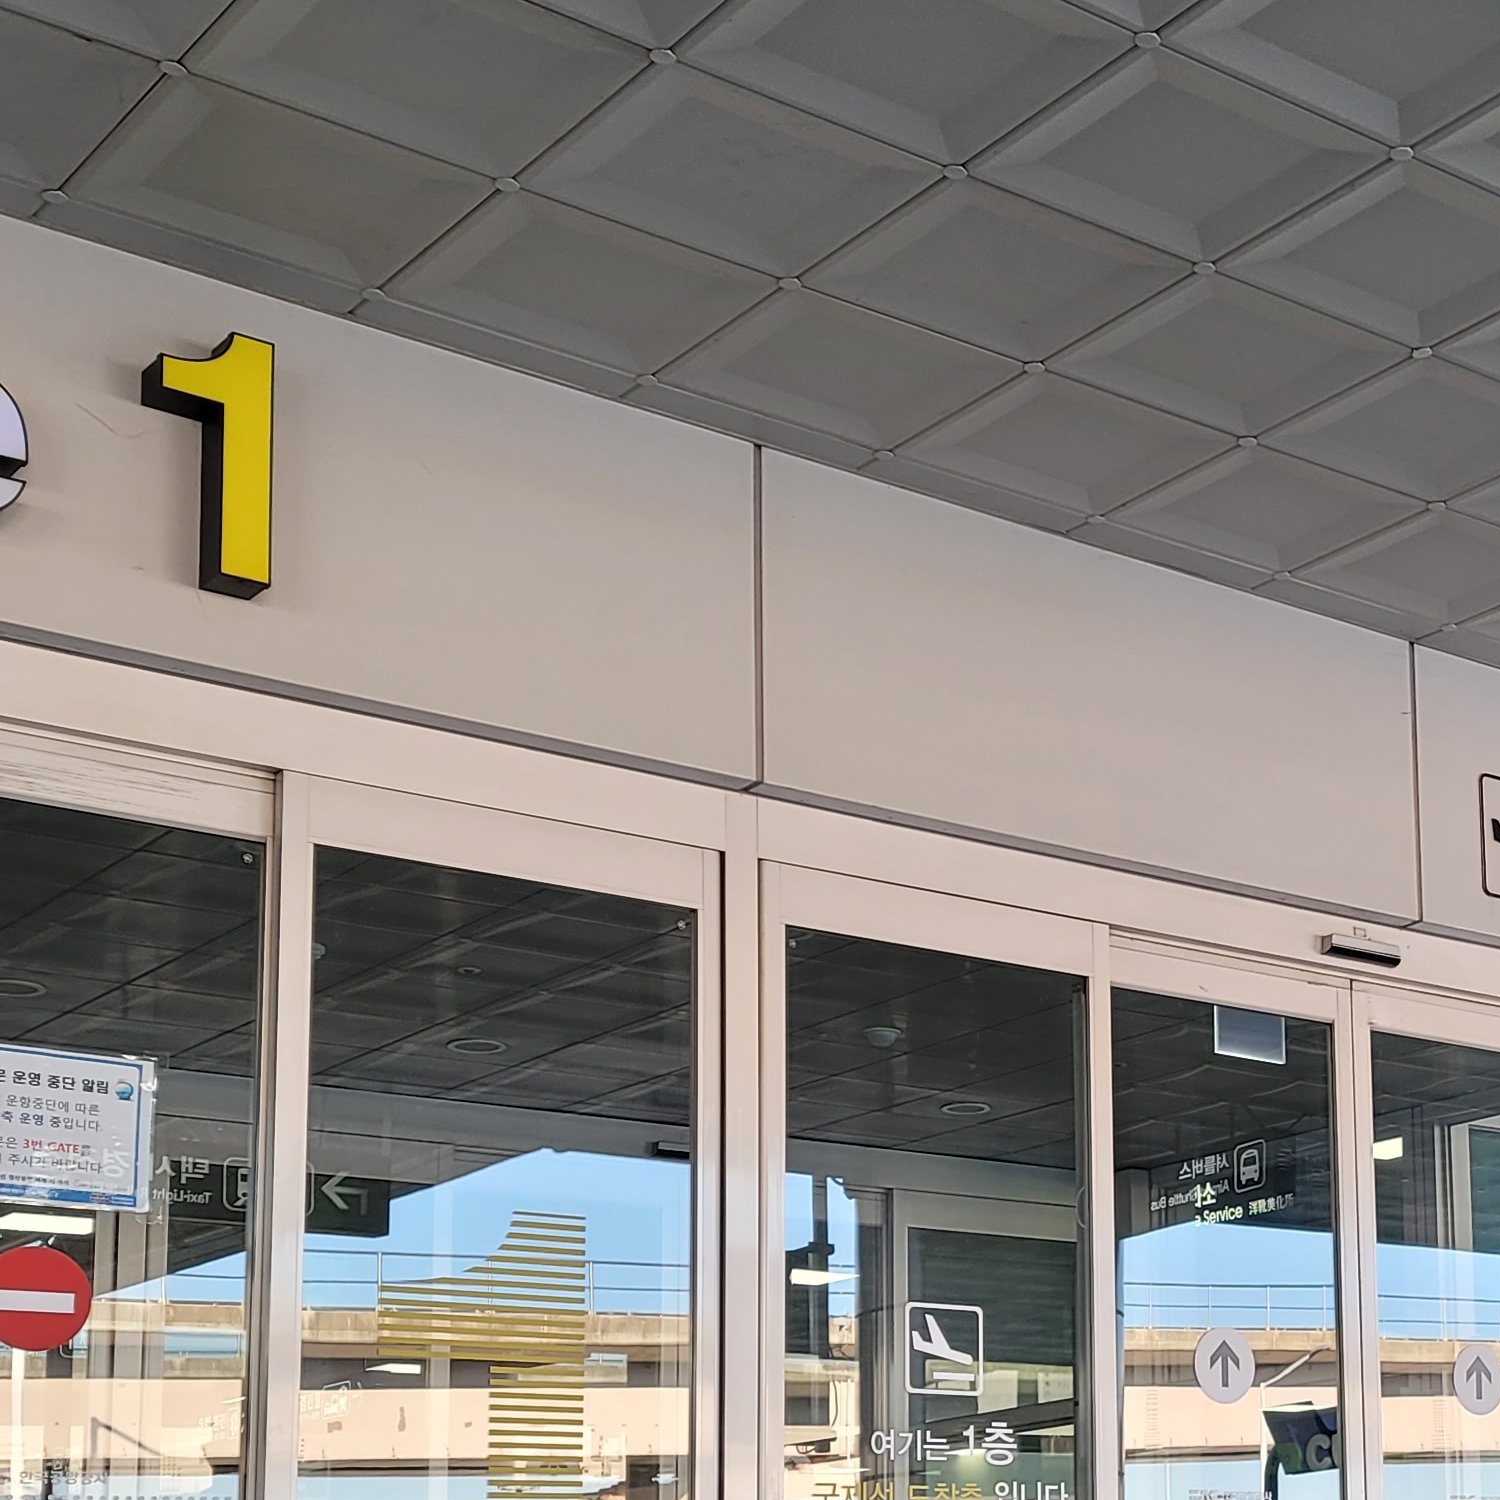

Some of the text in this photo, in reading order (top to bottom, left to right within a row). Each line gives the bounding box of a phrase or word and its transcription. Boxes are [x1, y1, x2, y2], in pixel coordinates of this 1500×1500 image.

[142, 331, 275, 600] 1
[13, 1070, 41, 1088] 운영
[47, 1074, 76, 1091] 중단
[81, 1078, 109, 1095] 알림
[6, 1094, 100, 1117] 운항중단에 따른
[19, 1112, 44, 1127] 운영
[23, 1138, 42, 1152] 3번
[1203, 1204, 1244, 1225] Service
[870, 1420, 1018, 1466] 여기는 1층
